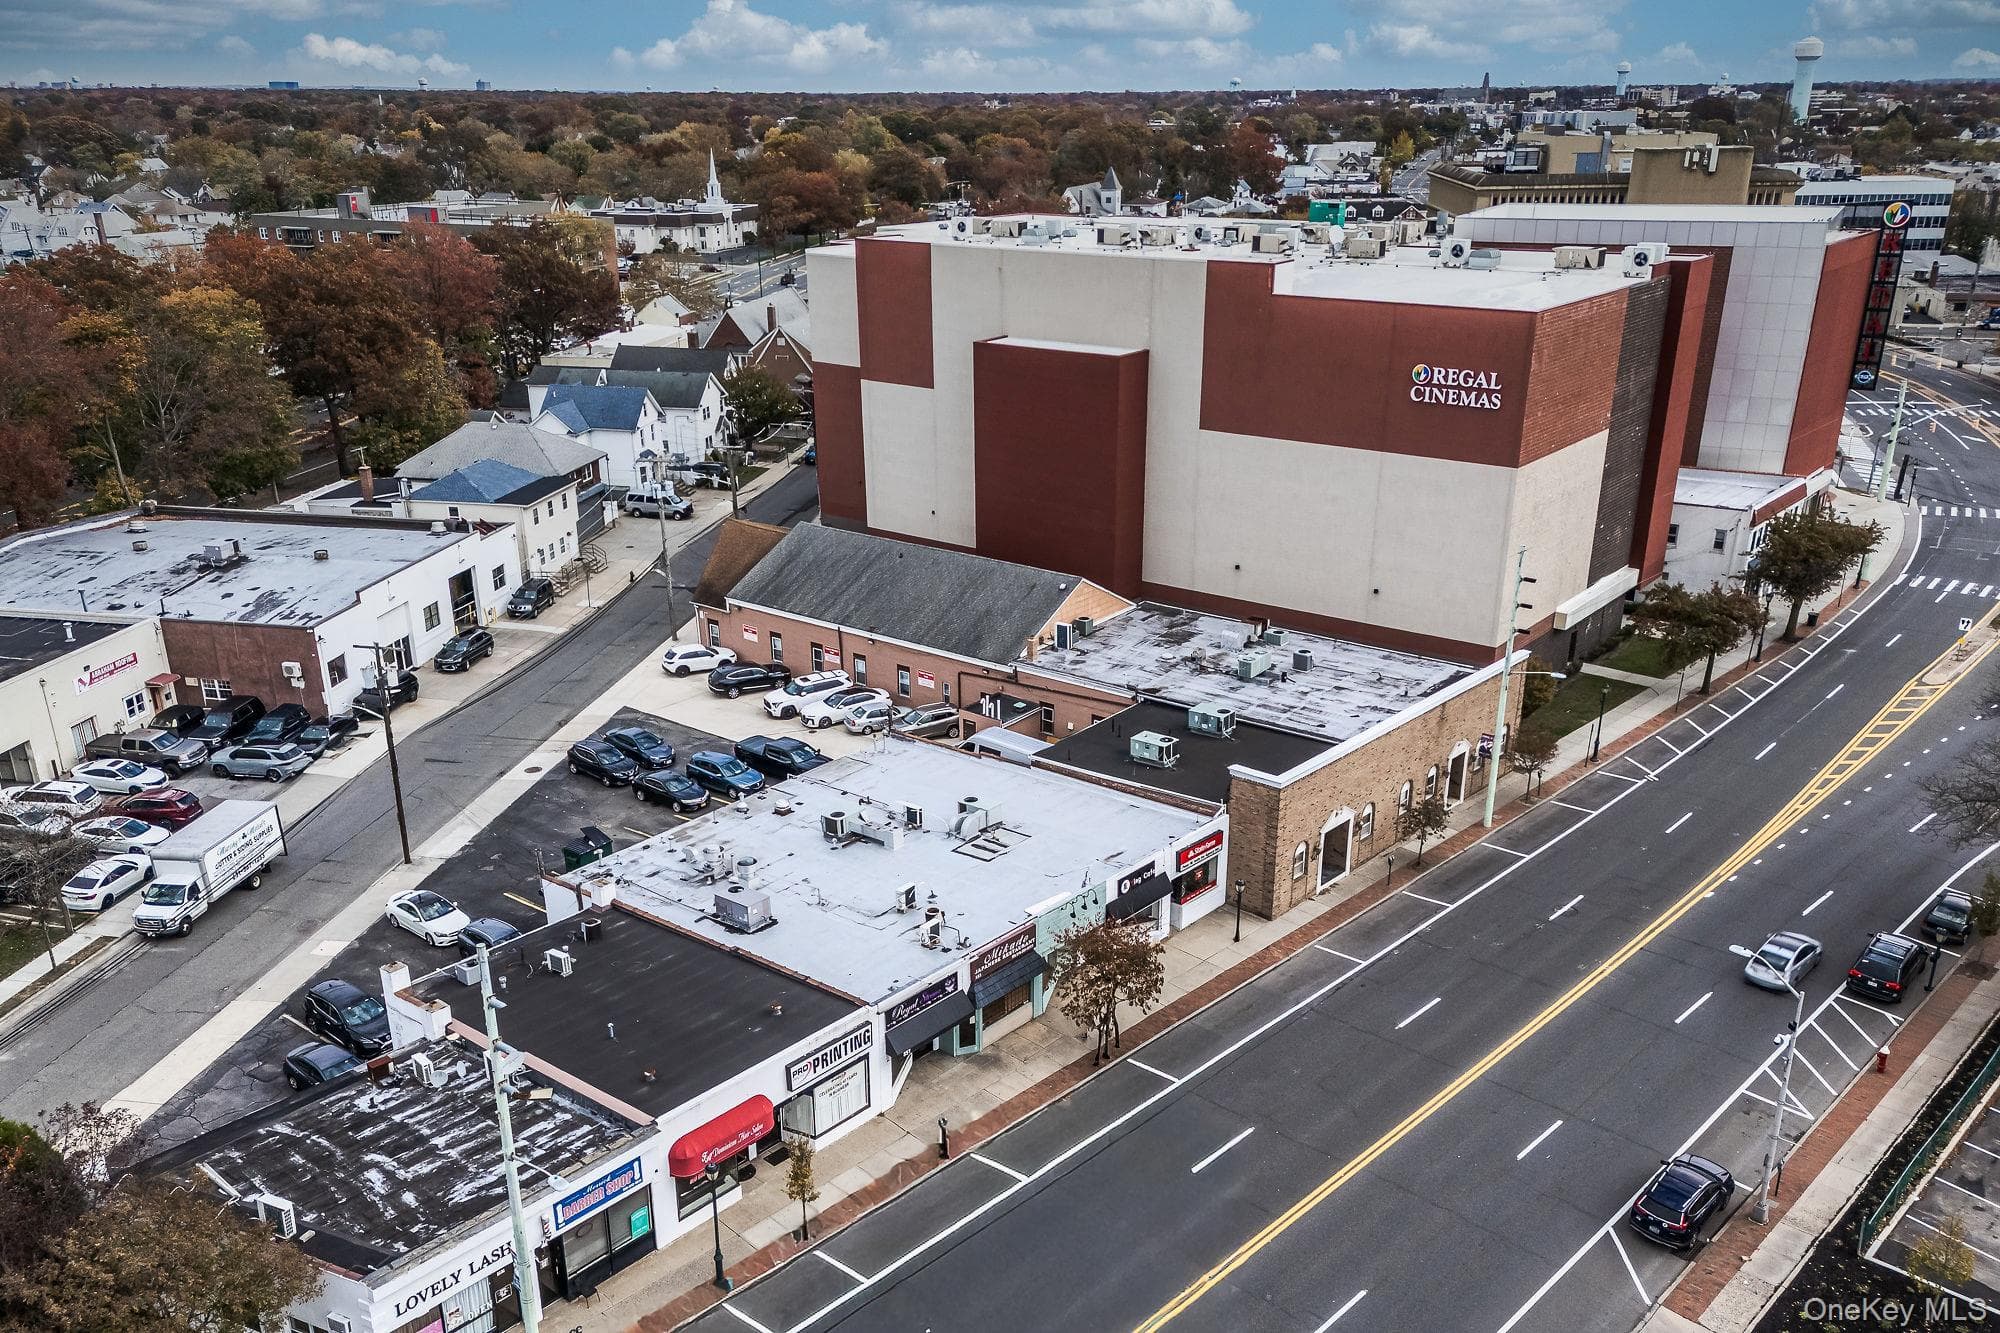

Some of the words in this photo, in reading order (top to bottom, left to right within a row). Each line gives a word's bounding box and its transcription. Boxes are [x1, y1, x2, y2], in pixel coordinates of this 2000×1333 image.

[1432, 366, 1502, 390] REGAL
[1410, 385, 1501, 410] CINEMAS
[253, 824, 274, 843] SUPPLIES
[974, 957, 1001, 975] JAPANESE
[1002, 937, 1036, 960] RESTAURANT
[983, 934, 1029, 964] Mikado
[892, 998, 919, 1019] Royal
[792, 1063, 808, 1078] PRO
[812, 1028, 871, 1074] PRINTING
[562, 1186, 605, 1219] BARBER
[605, 1170, 634, 1196] SHOP
[394, 1268, 463, 1318] LOVELY
